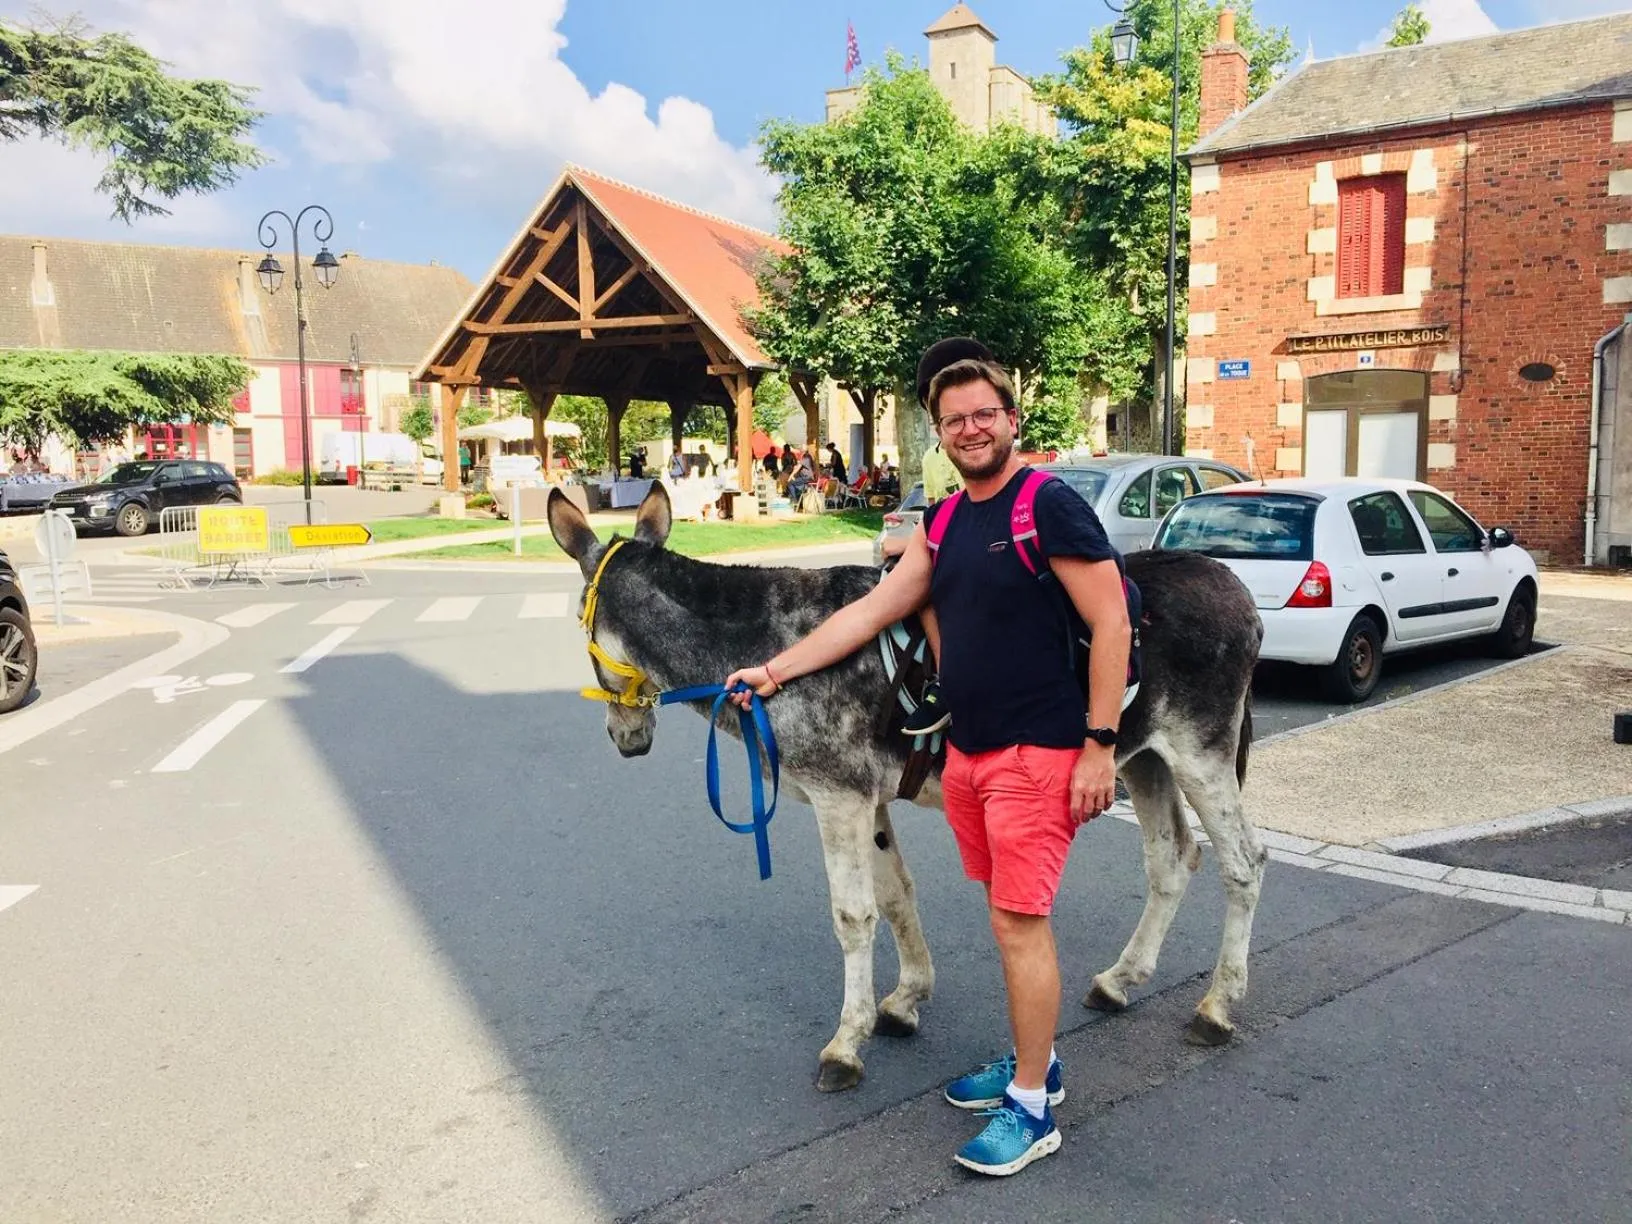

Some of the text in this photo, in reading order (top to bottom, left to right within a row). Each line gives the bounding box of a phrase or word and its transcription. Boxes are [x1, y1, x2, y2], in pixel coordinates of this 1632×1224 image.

[1293, 337, 1314, 350] LE
[1349, 331, 1406, 348] ATELIER
[1411, 328, 1444, 343] BOIS
[208, 515, 257, 527] ROUTE
